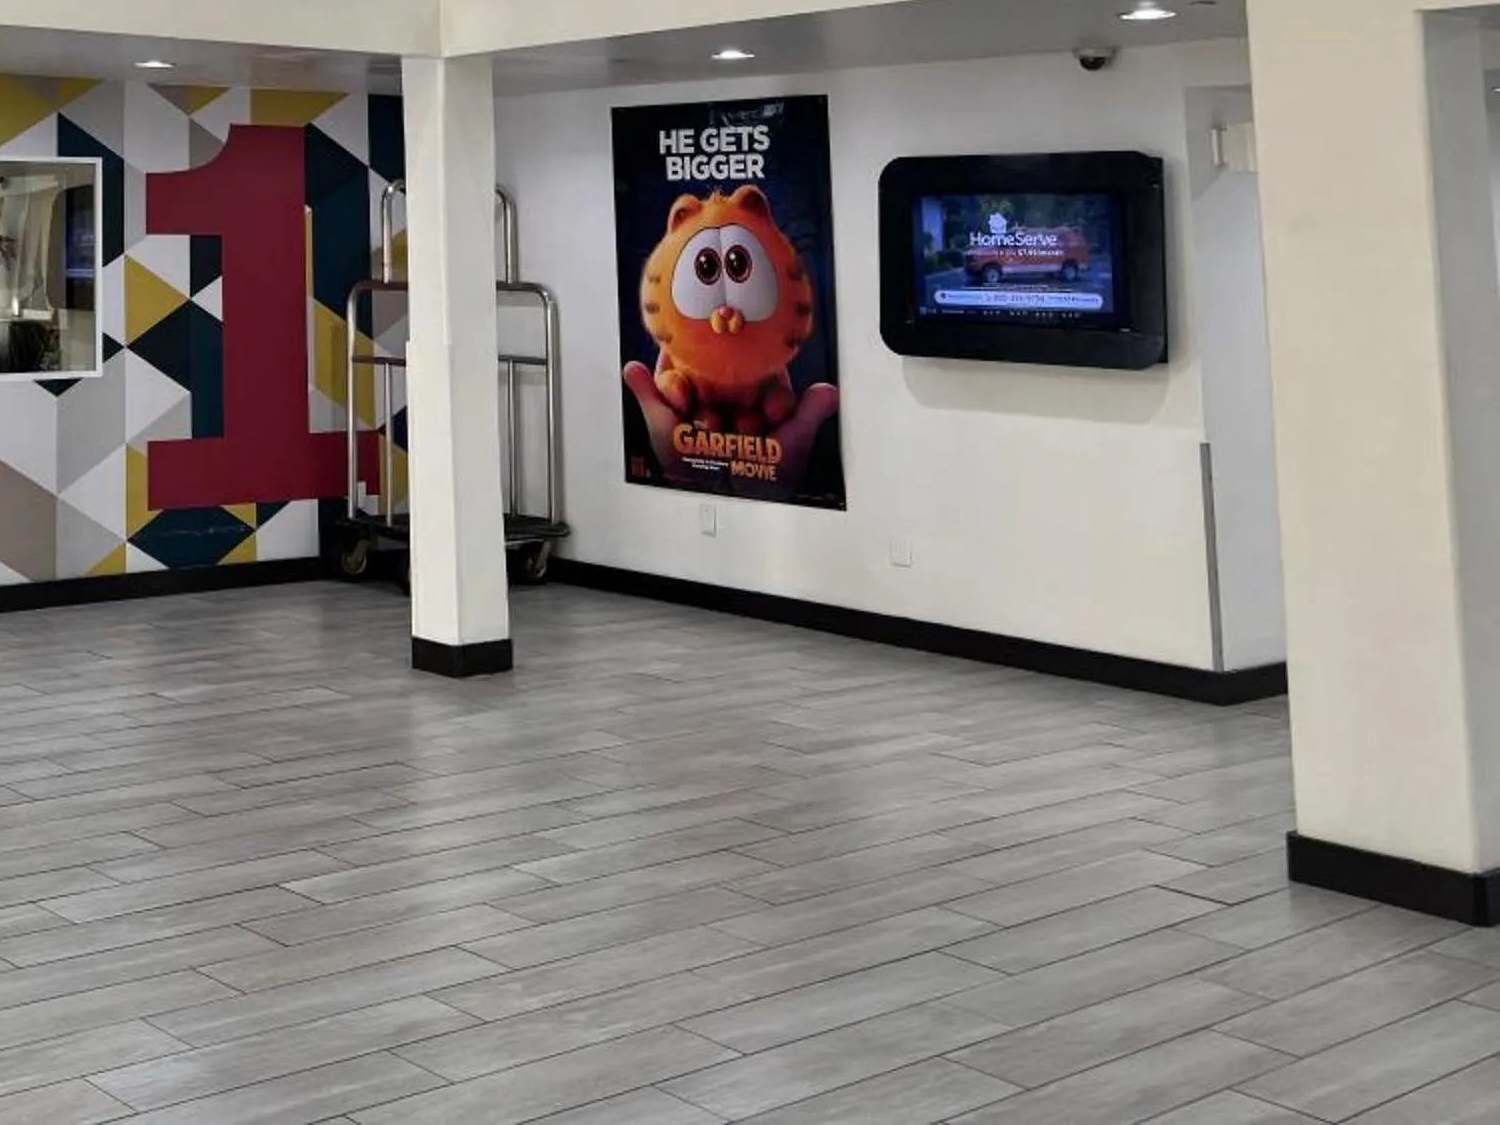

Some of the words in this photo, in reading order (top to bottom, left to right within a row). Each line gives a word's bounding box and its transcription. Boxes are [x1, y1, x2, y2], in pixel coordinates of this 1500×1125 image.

[659, 128, 695, 154] HE
[700, 124, 770, 153] GETS
[665, 153, 765, 181] BIGGER
[968, 231, 1058, 247] HomeServe
[146, 123, 380, 510] 1
[672, 422, 783, 464] GARFIELD
[730, 460, 778, 482] MOVIE
